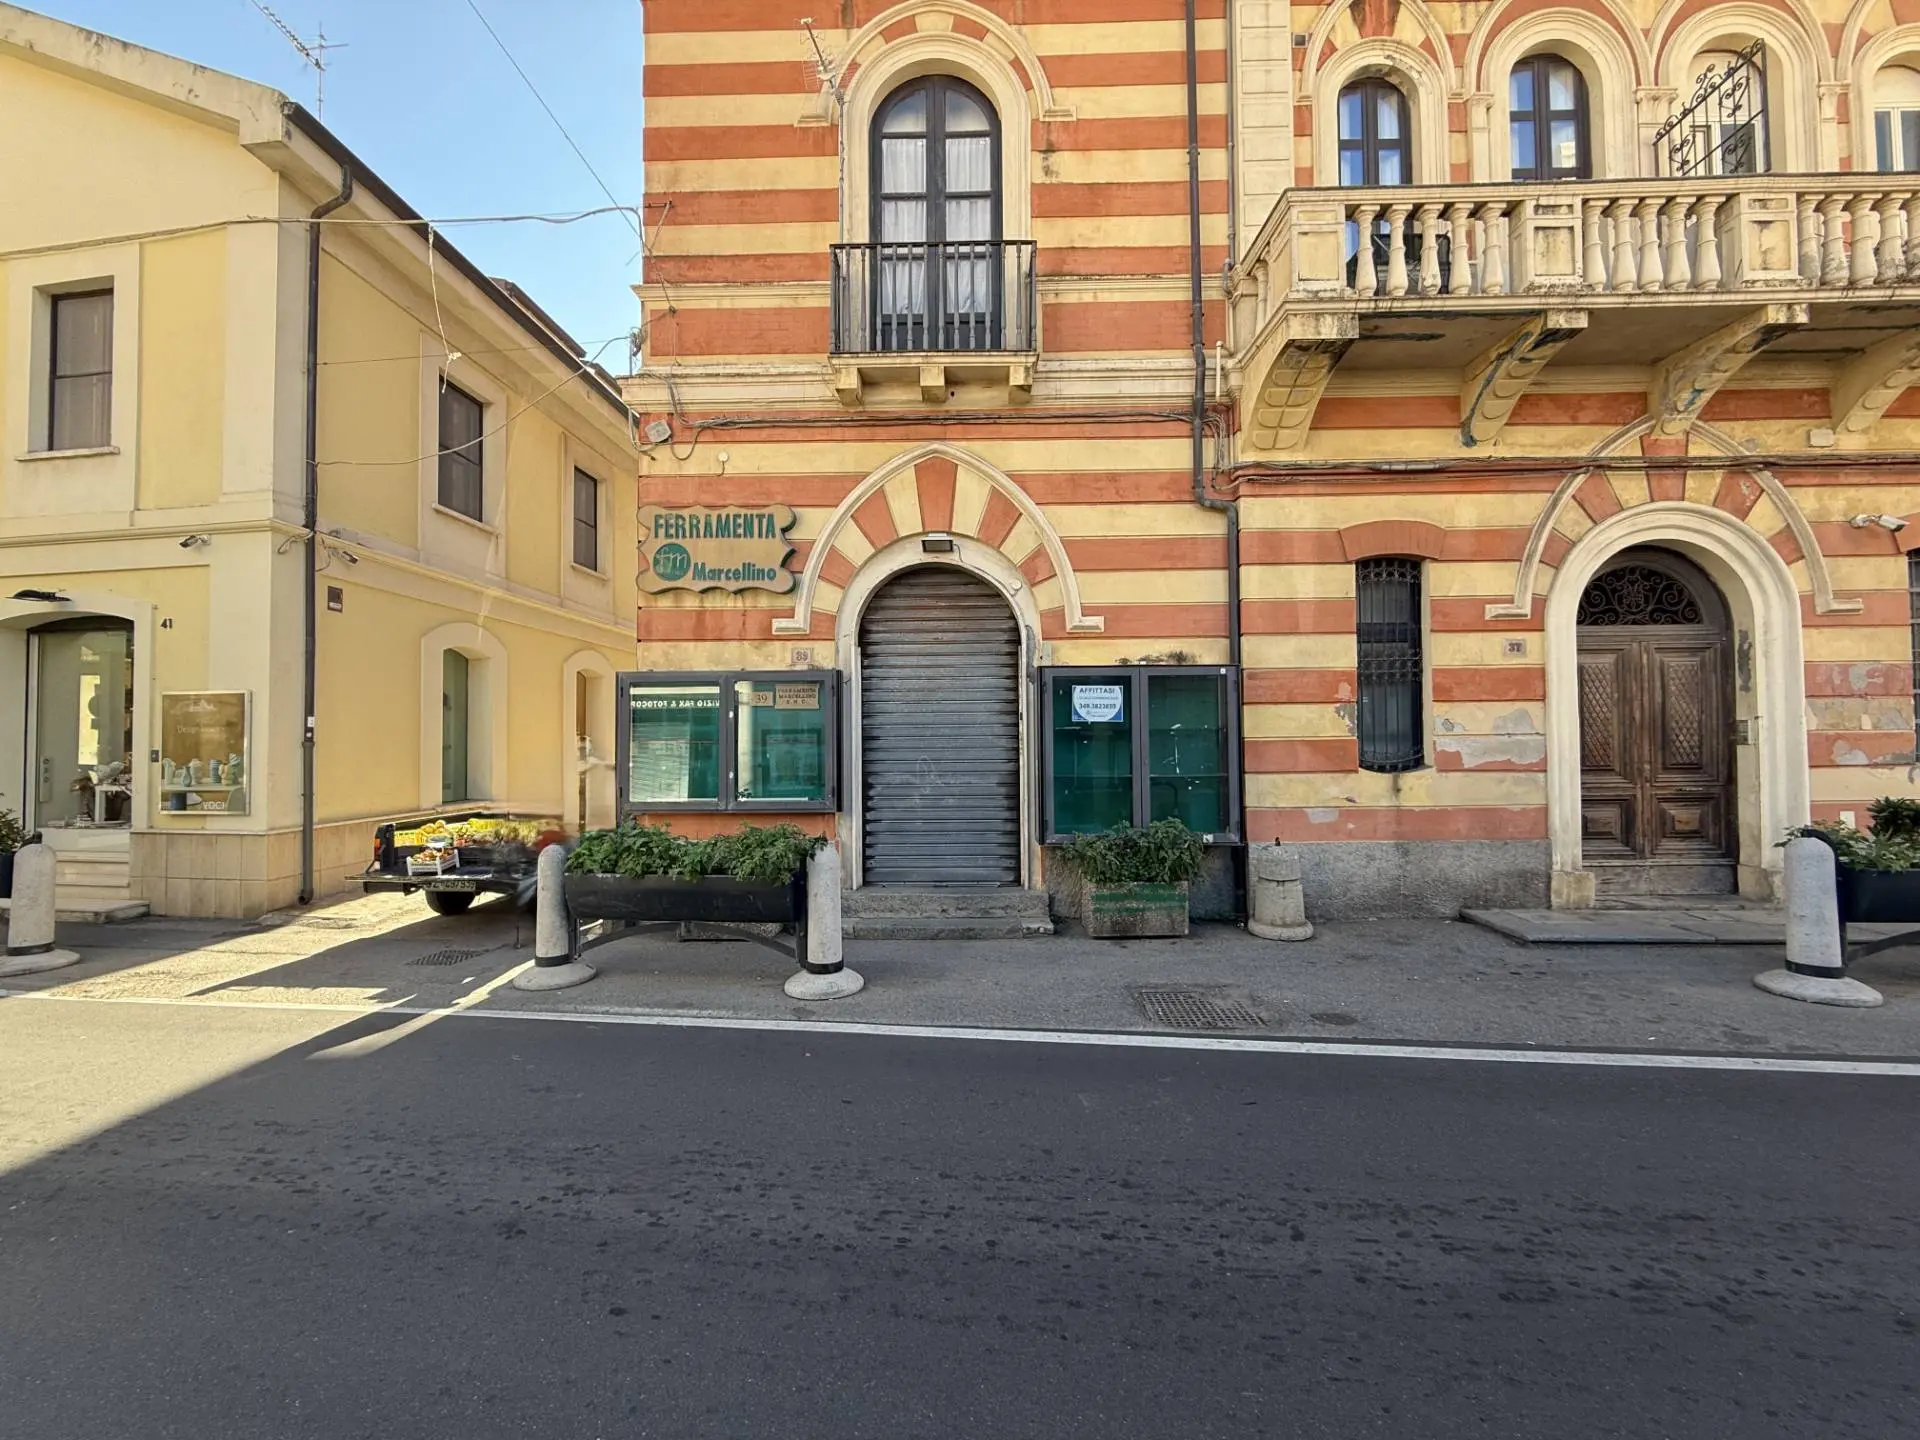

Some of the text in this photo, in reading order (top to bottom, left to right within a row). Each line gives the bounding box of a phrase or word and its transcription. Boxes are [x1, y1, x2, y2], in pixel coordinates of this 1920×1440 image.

[654, 513, 776, 538] FERRAMENTA
[692, 562, 777, 582] Marcellino
[160, 618, 173, 629] 41
[1508, 642, 1523, 652] 37
